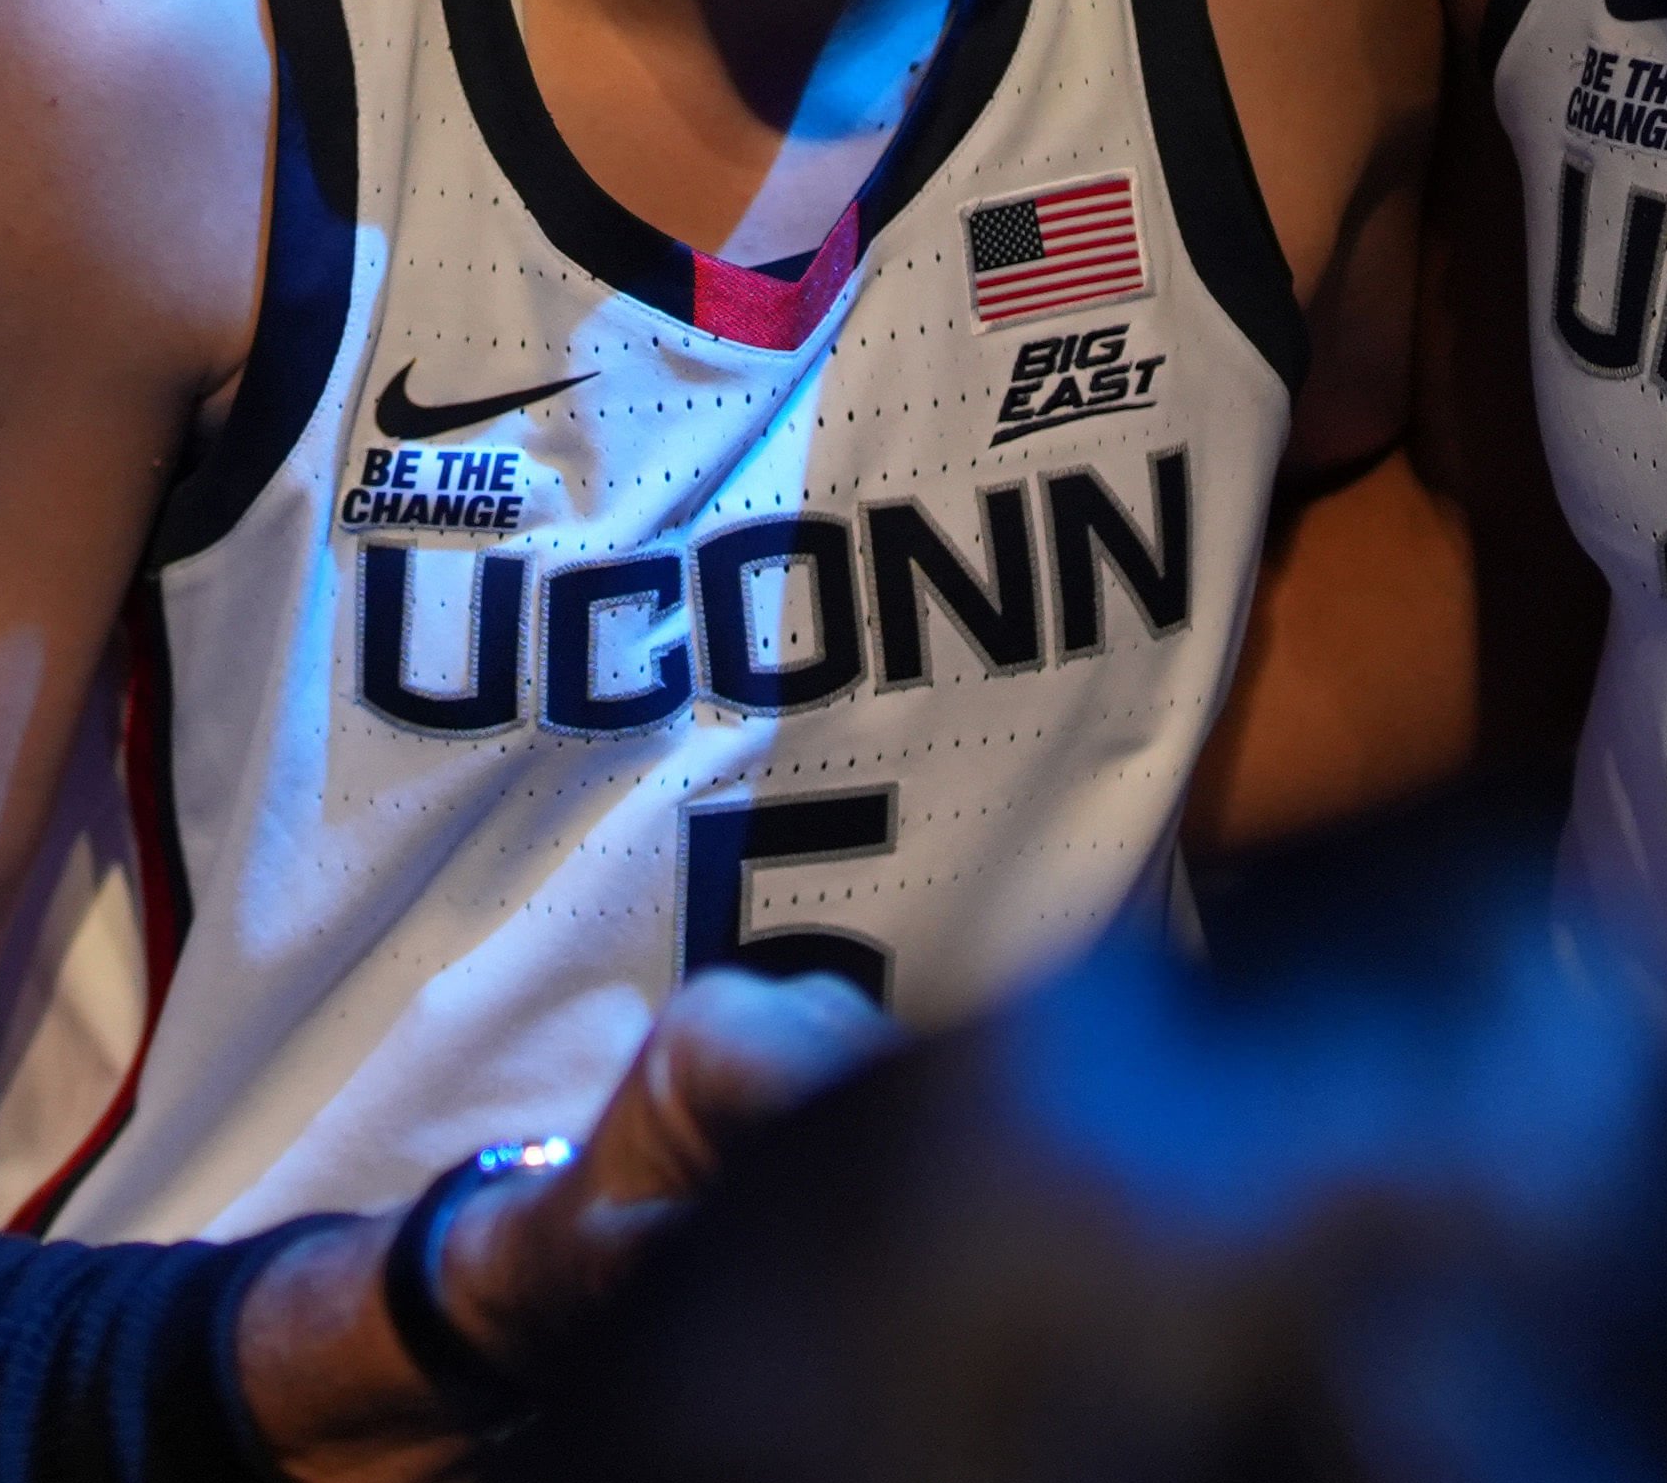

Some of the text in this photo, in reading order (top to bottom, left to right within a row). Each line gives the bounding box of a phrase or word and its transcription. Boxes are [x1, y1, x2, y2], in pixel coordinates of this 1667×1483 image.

[1581, 46, 1619, 93] BE
[1011, 323, 1131, 383] BIG
[997, 354, 1167, 423] EAST
[360, 447, 520, 491] BE THE
[342, 488, 524, 529] CHANGE
[355, 443, 1194, 741] UCONN
[675, 782, 899, 1014] 5
